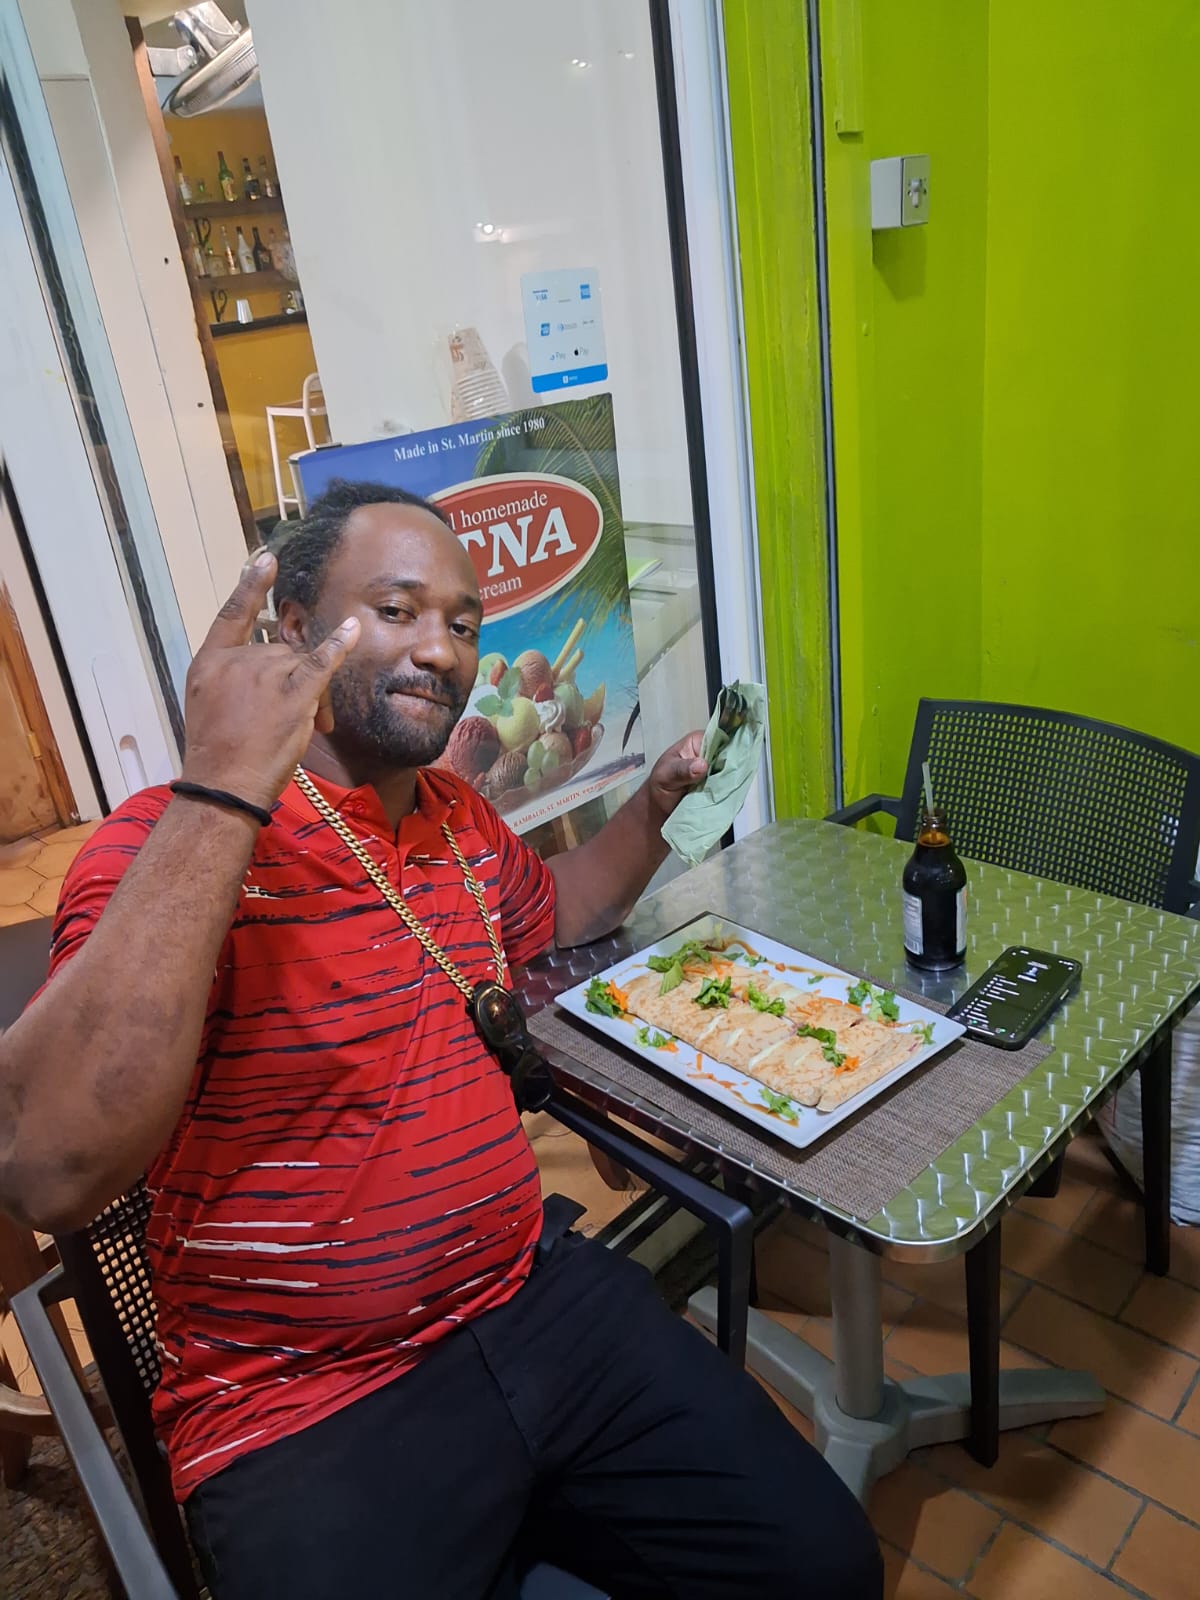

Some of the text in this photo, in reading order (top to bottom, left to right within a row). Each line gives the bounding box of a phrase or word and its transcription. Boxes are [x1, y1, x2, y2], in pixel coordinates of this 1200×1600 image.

[394, 416, 545, 462] Made in St. Martin since 1980
[460, 490, 548, 529] homemade
